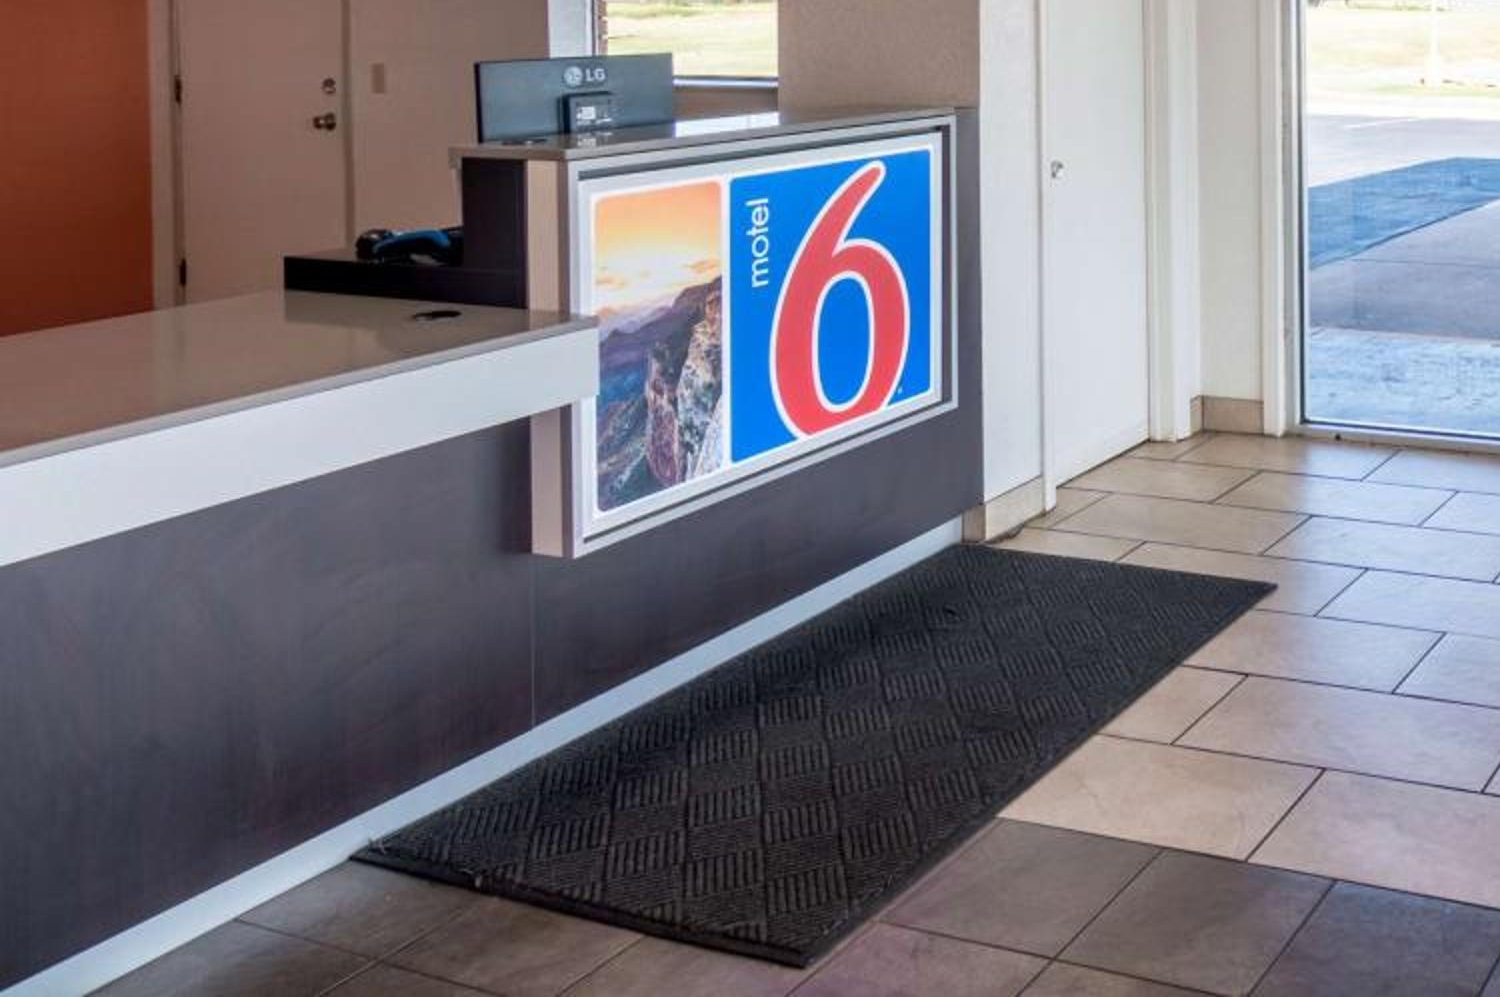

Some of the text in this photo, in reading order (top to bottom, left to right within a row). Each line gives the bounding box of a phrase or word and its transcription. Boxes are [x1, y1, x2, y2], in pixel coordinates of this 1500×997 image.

[586, 68, 606, 82] LG
[745, 160, 910, 440] motel 6
